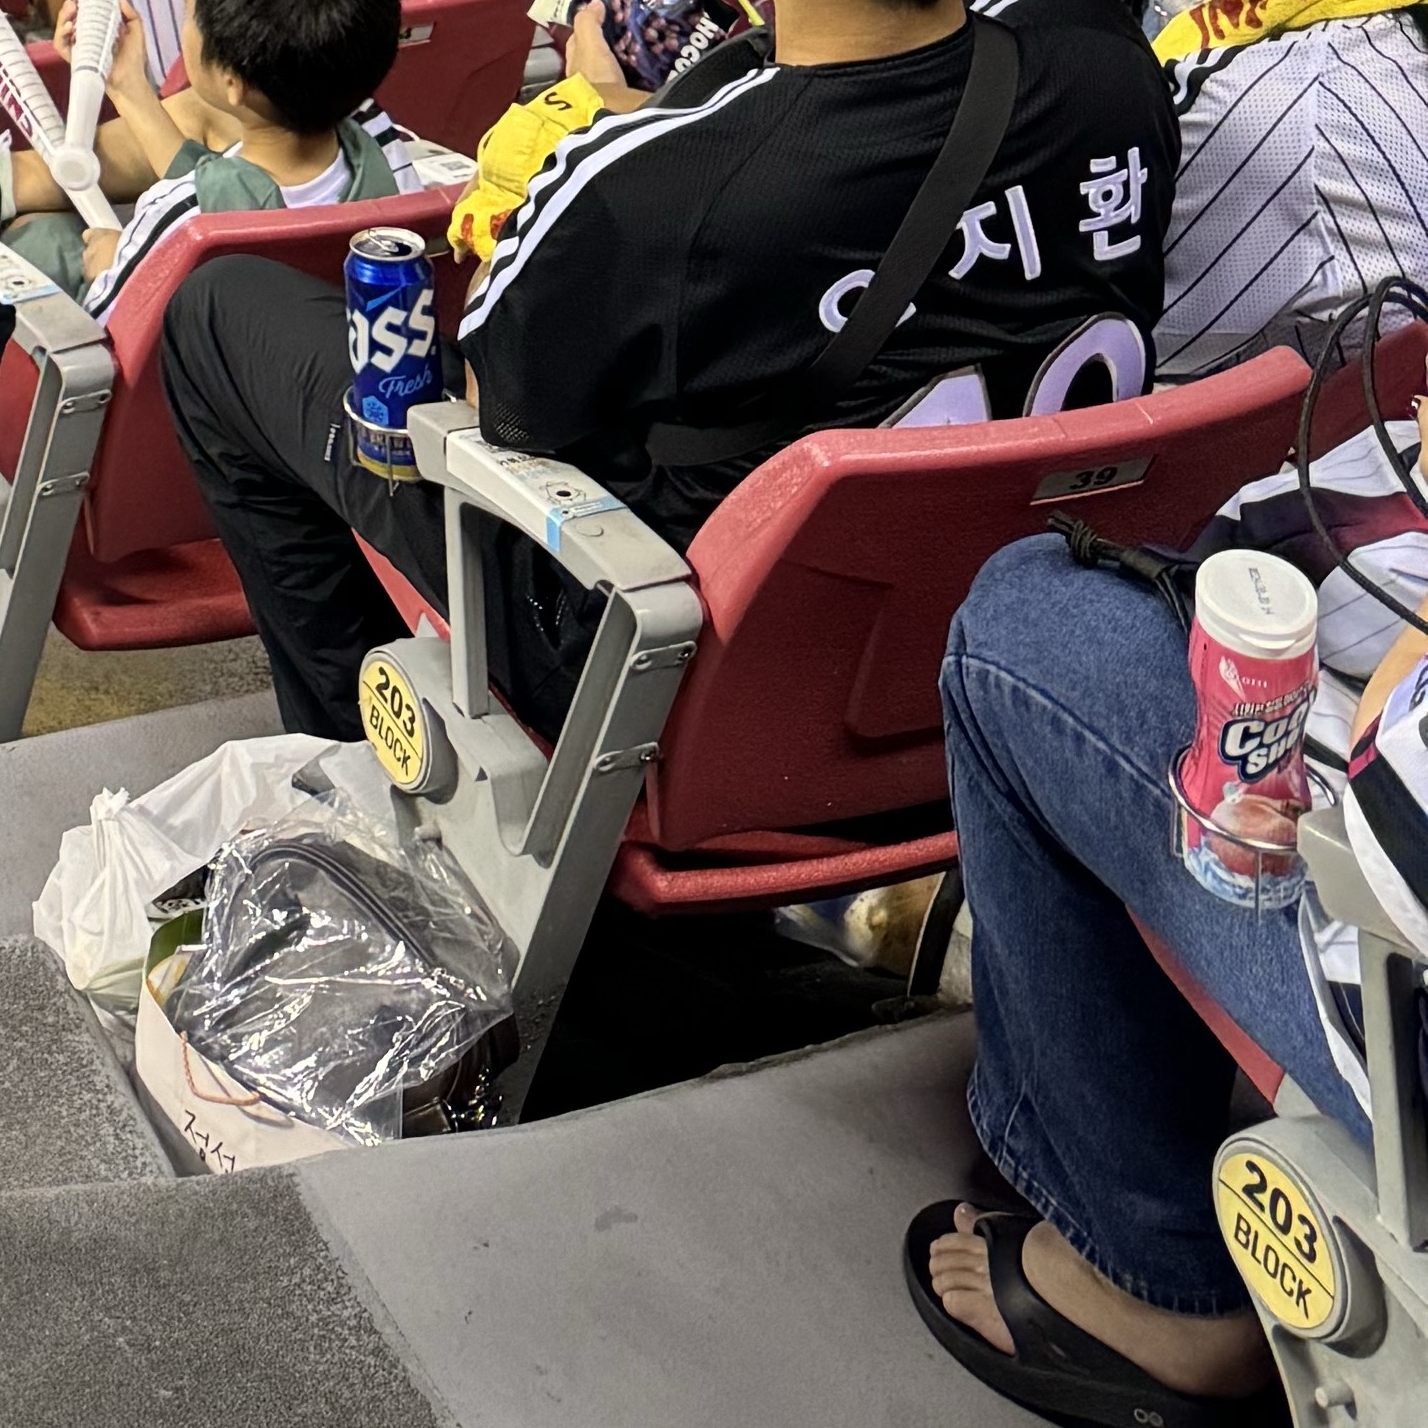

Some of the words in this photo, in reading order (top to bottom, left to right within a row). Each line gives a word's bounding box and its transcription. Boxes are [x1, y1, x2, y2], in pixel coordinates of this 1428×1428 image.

[667, 9, 720, 83] HOCO
[378, 361, 434, 399] Fresh
[1070, 465, 1118, 491] 39
[377, 665, 417, 739] 203
[369, 702, 412, 777] BLOCK
[1241, 1159, 1318, 1265] 203
[1233, 1212, 1313, 1320] BLOCK
